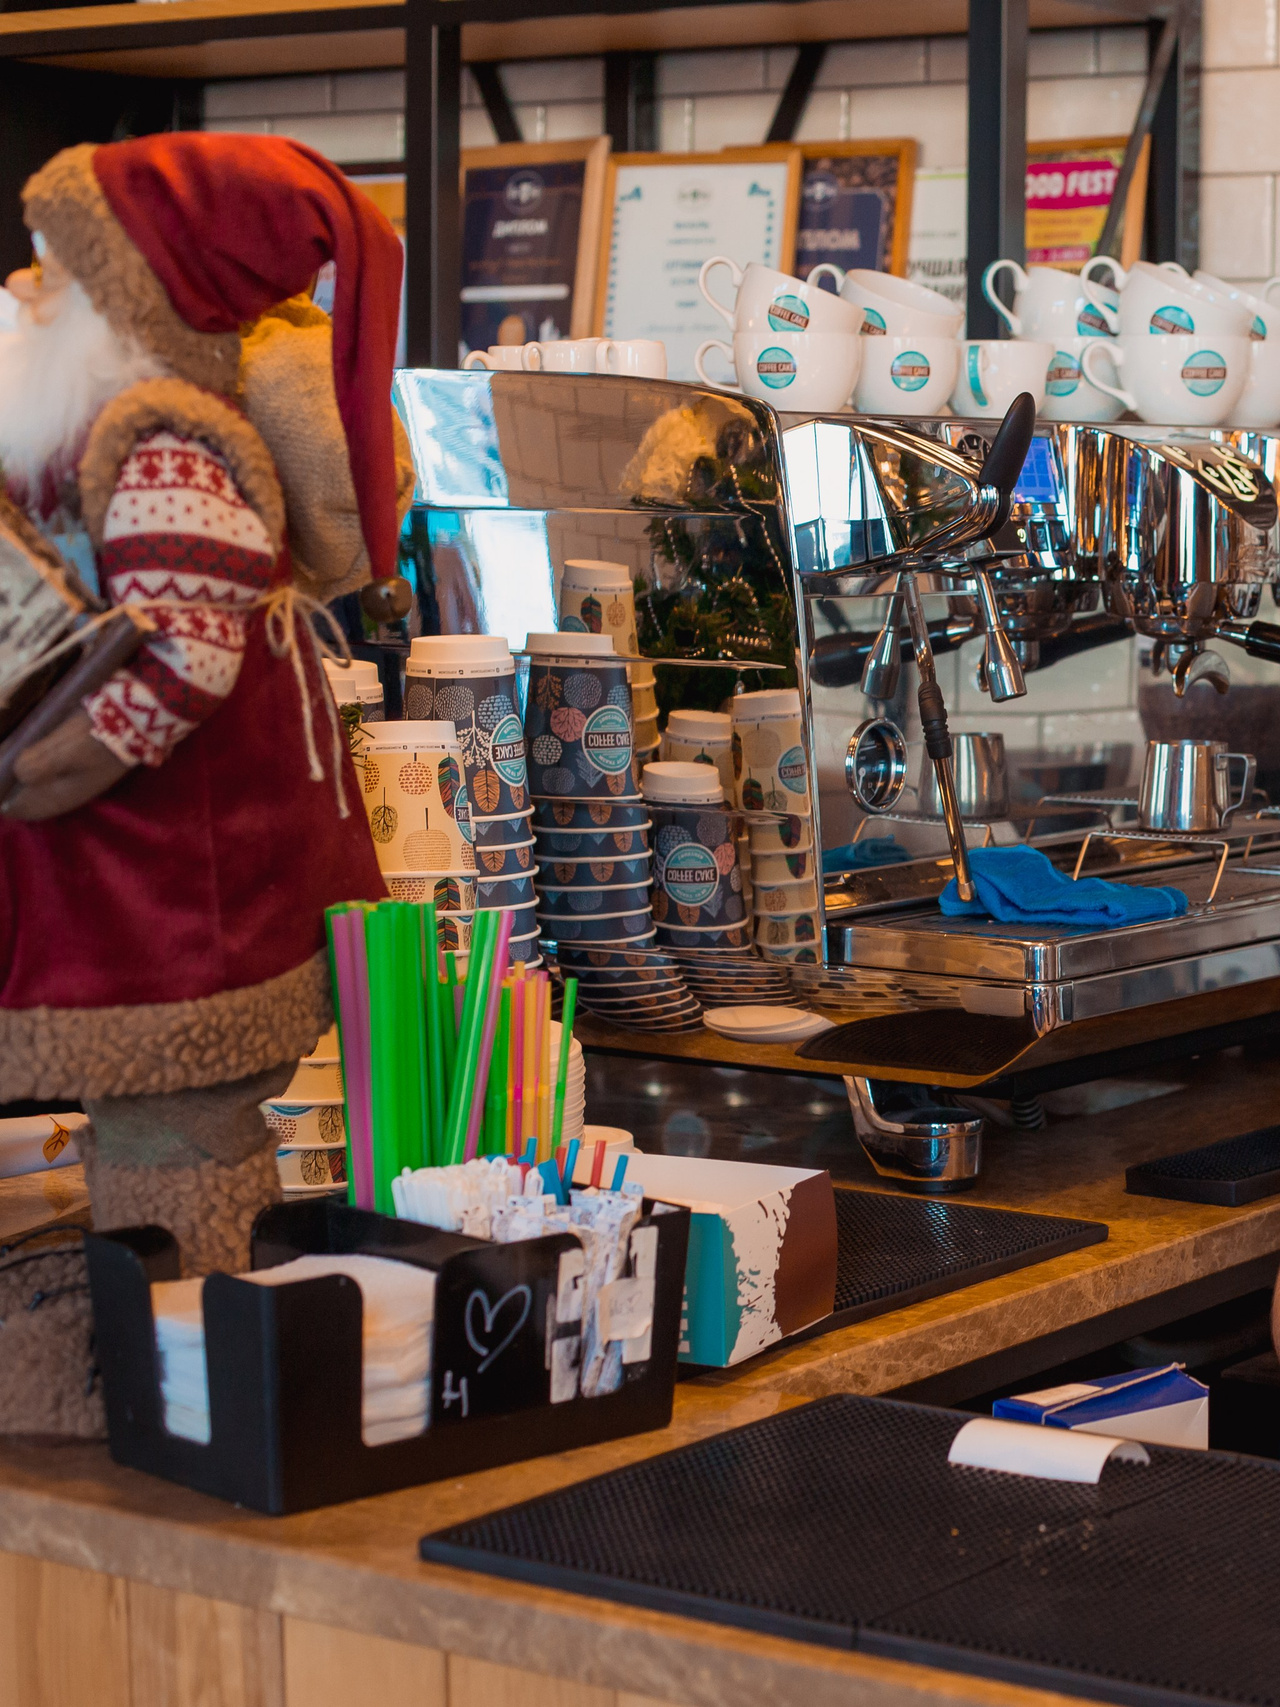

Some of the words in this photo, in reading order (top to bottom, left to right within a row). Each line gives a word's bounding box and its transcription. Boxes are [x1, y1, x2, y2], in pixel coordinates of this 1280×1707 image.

[1025, 172, 1064, 199] OOD
[1066, 168, 1117, 197] FEST
[495, 744, 515, 760] CAKE
